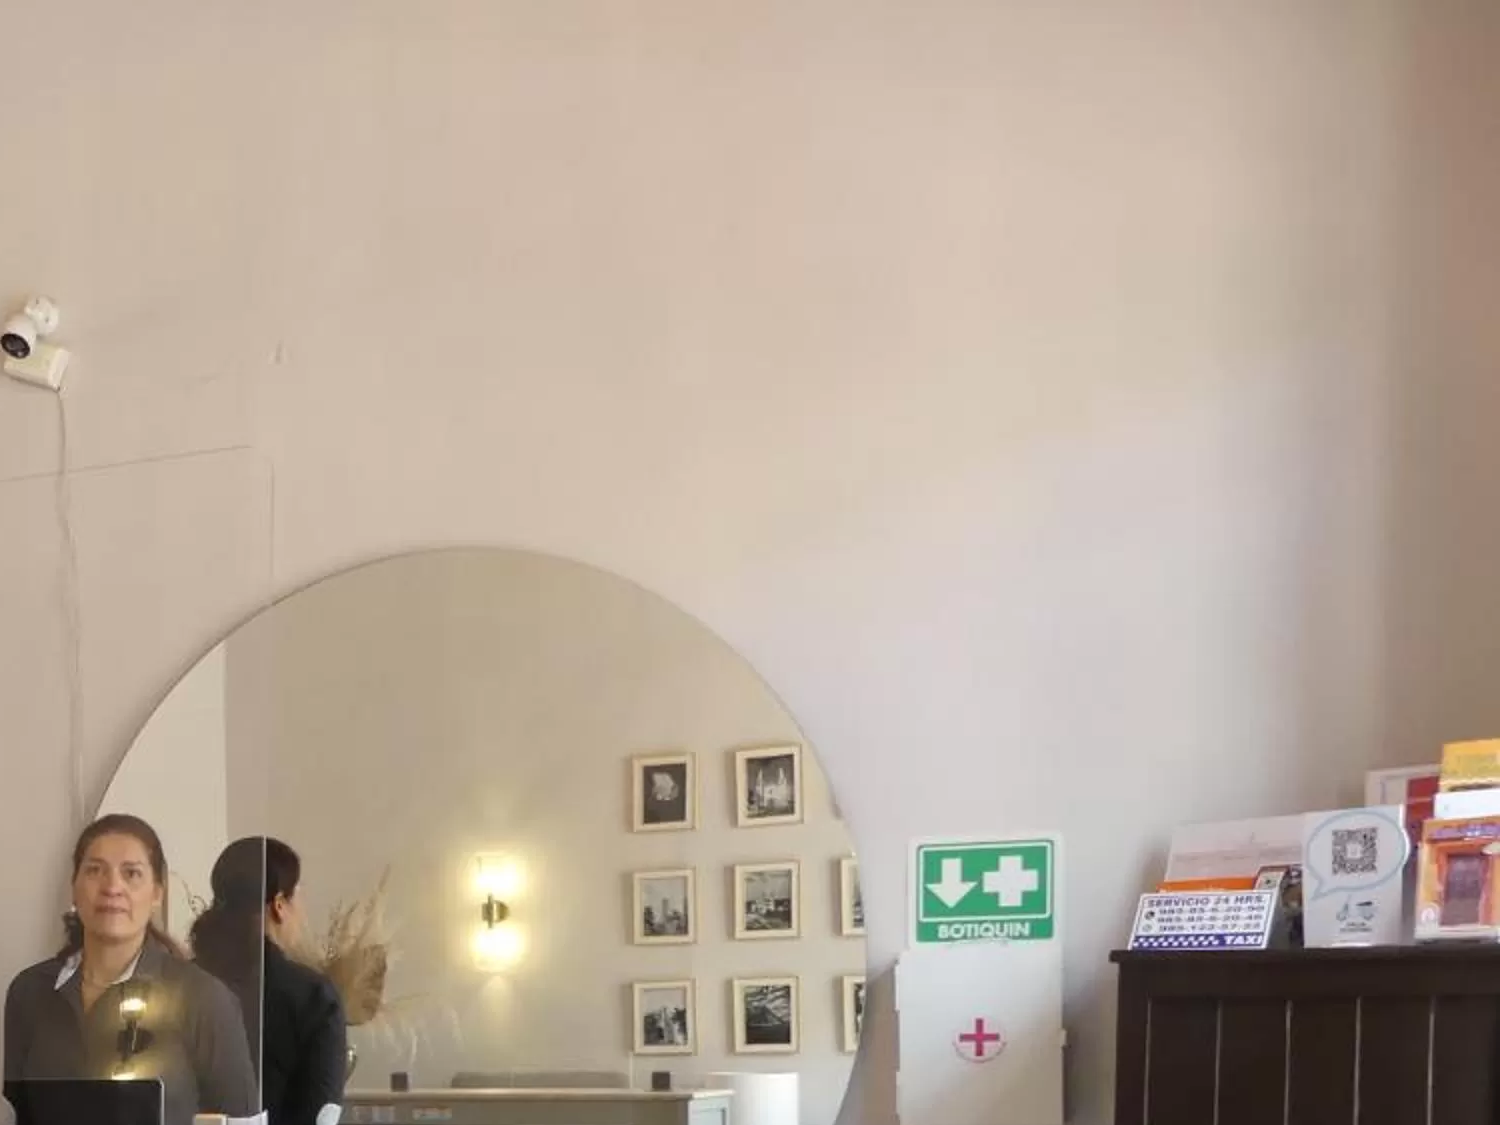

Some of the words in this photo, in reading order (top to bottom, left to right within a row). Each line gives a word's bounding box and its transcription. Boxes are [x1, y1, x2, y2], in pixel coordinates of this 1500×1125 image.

[1148, 898, 1209, 907] SERVICIO
[938, 921, 1030, 939] BOTIQUIN
[1224, 935, 1263, 945] TAXI
